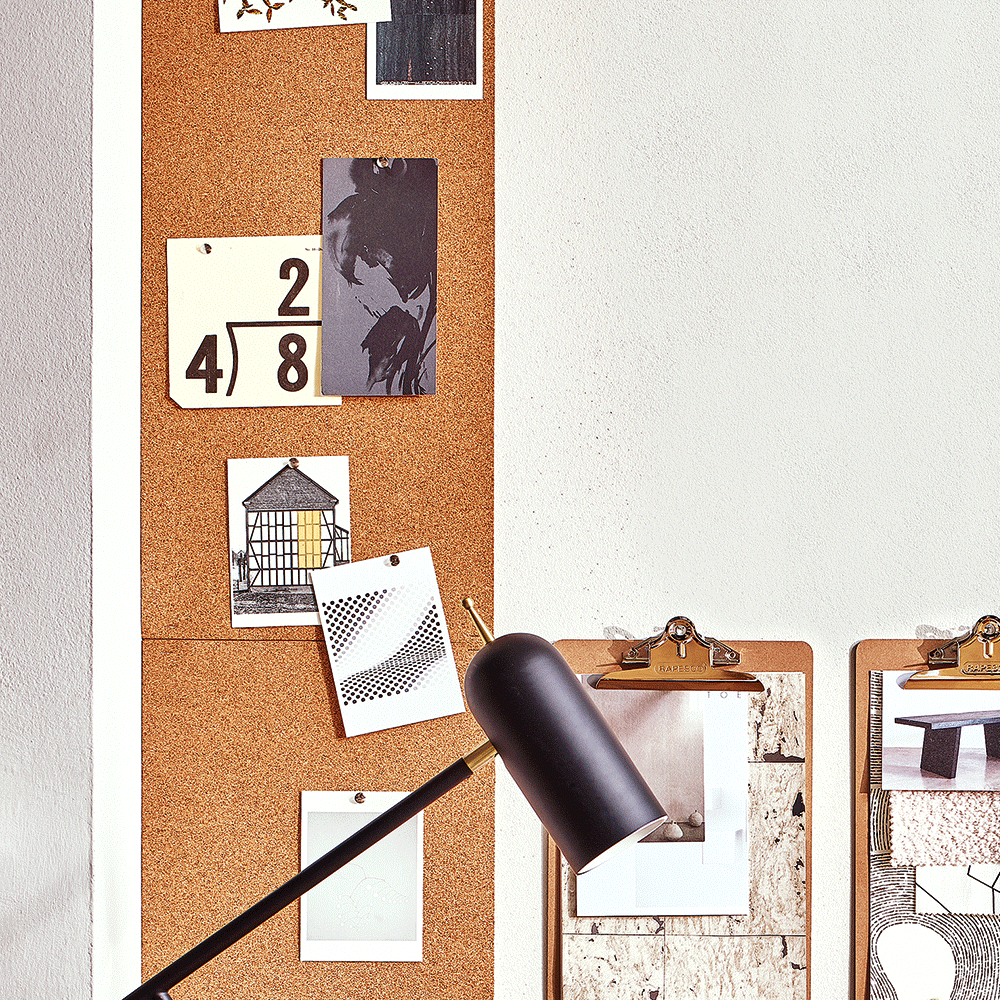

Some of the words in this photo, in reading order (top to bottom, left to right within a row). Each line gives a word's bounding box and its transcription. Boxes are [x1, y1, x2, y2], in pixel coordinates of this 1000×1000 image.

[278, 258, 310, 316] 2
[185, 334, 223, 393] 4
[277, 333, 308, 392] 8
